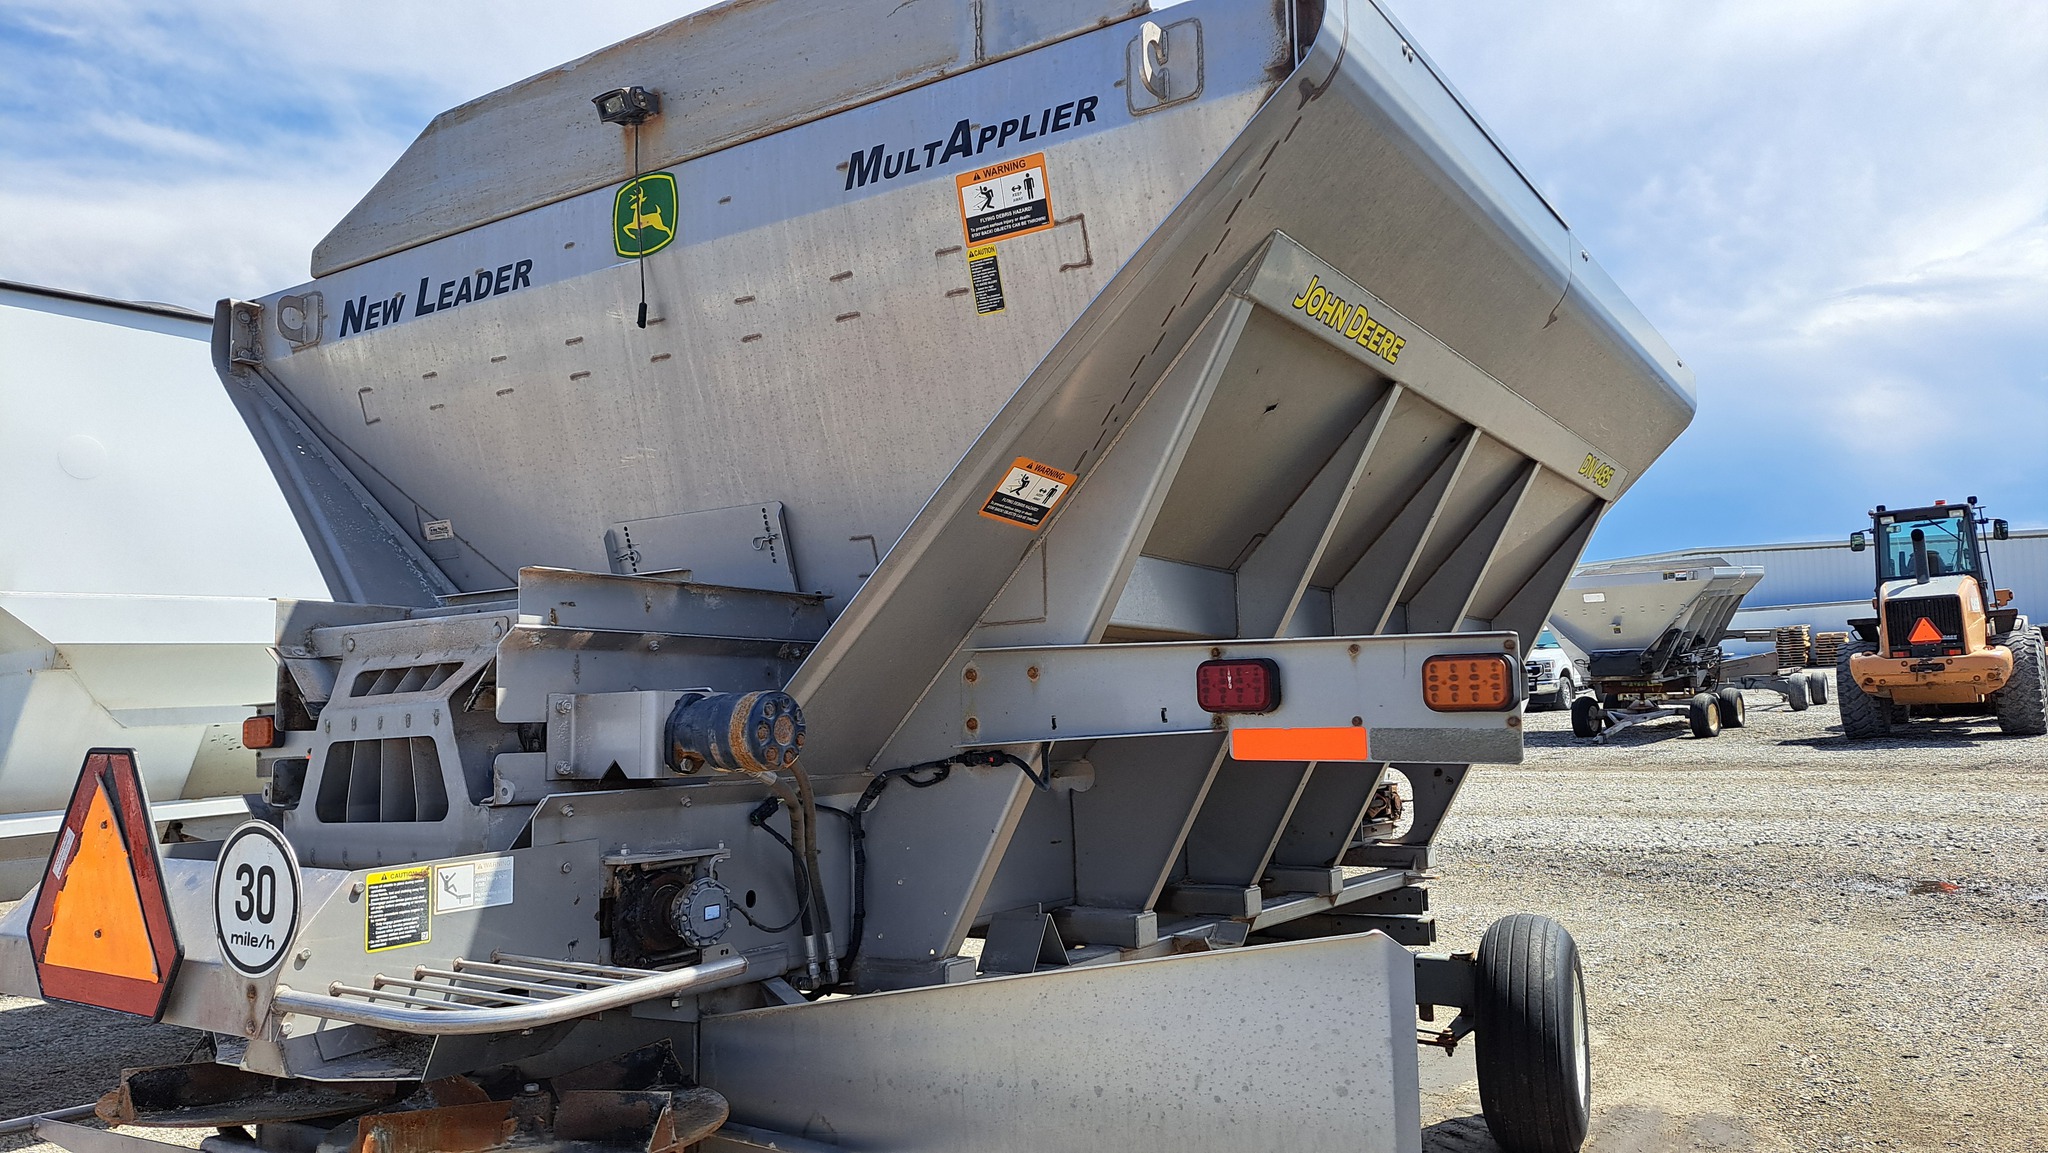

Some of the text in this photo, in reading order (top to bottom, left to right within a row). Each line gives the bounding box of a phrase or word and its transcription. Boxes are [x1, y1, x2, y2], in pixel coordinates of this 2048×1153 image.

[845, 95, 1098, 191] MULTAPPLIER
[983, 159, 1026, 179] WARNING
[980, 215, 995, 223] FLYING
[996, 211, 1012, 219] DEBRIS
[974, 246, 995, 256] CAUTION
[339, 258, 533, 338] NEW LEADER
[1292, 274, 1406, 365] JOHN DEERE
[1034, 464, 1066, 480] WARNING
[235, 863, 276, 924] 30
[230, 931, 275, 950] mile/h
